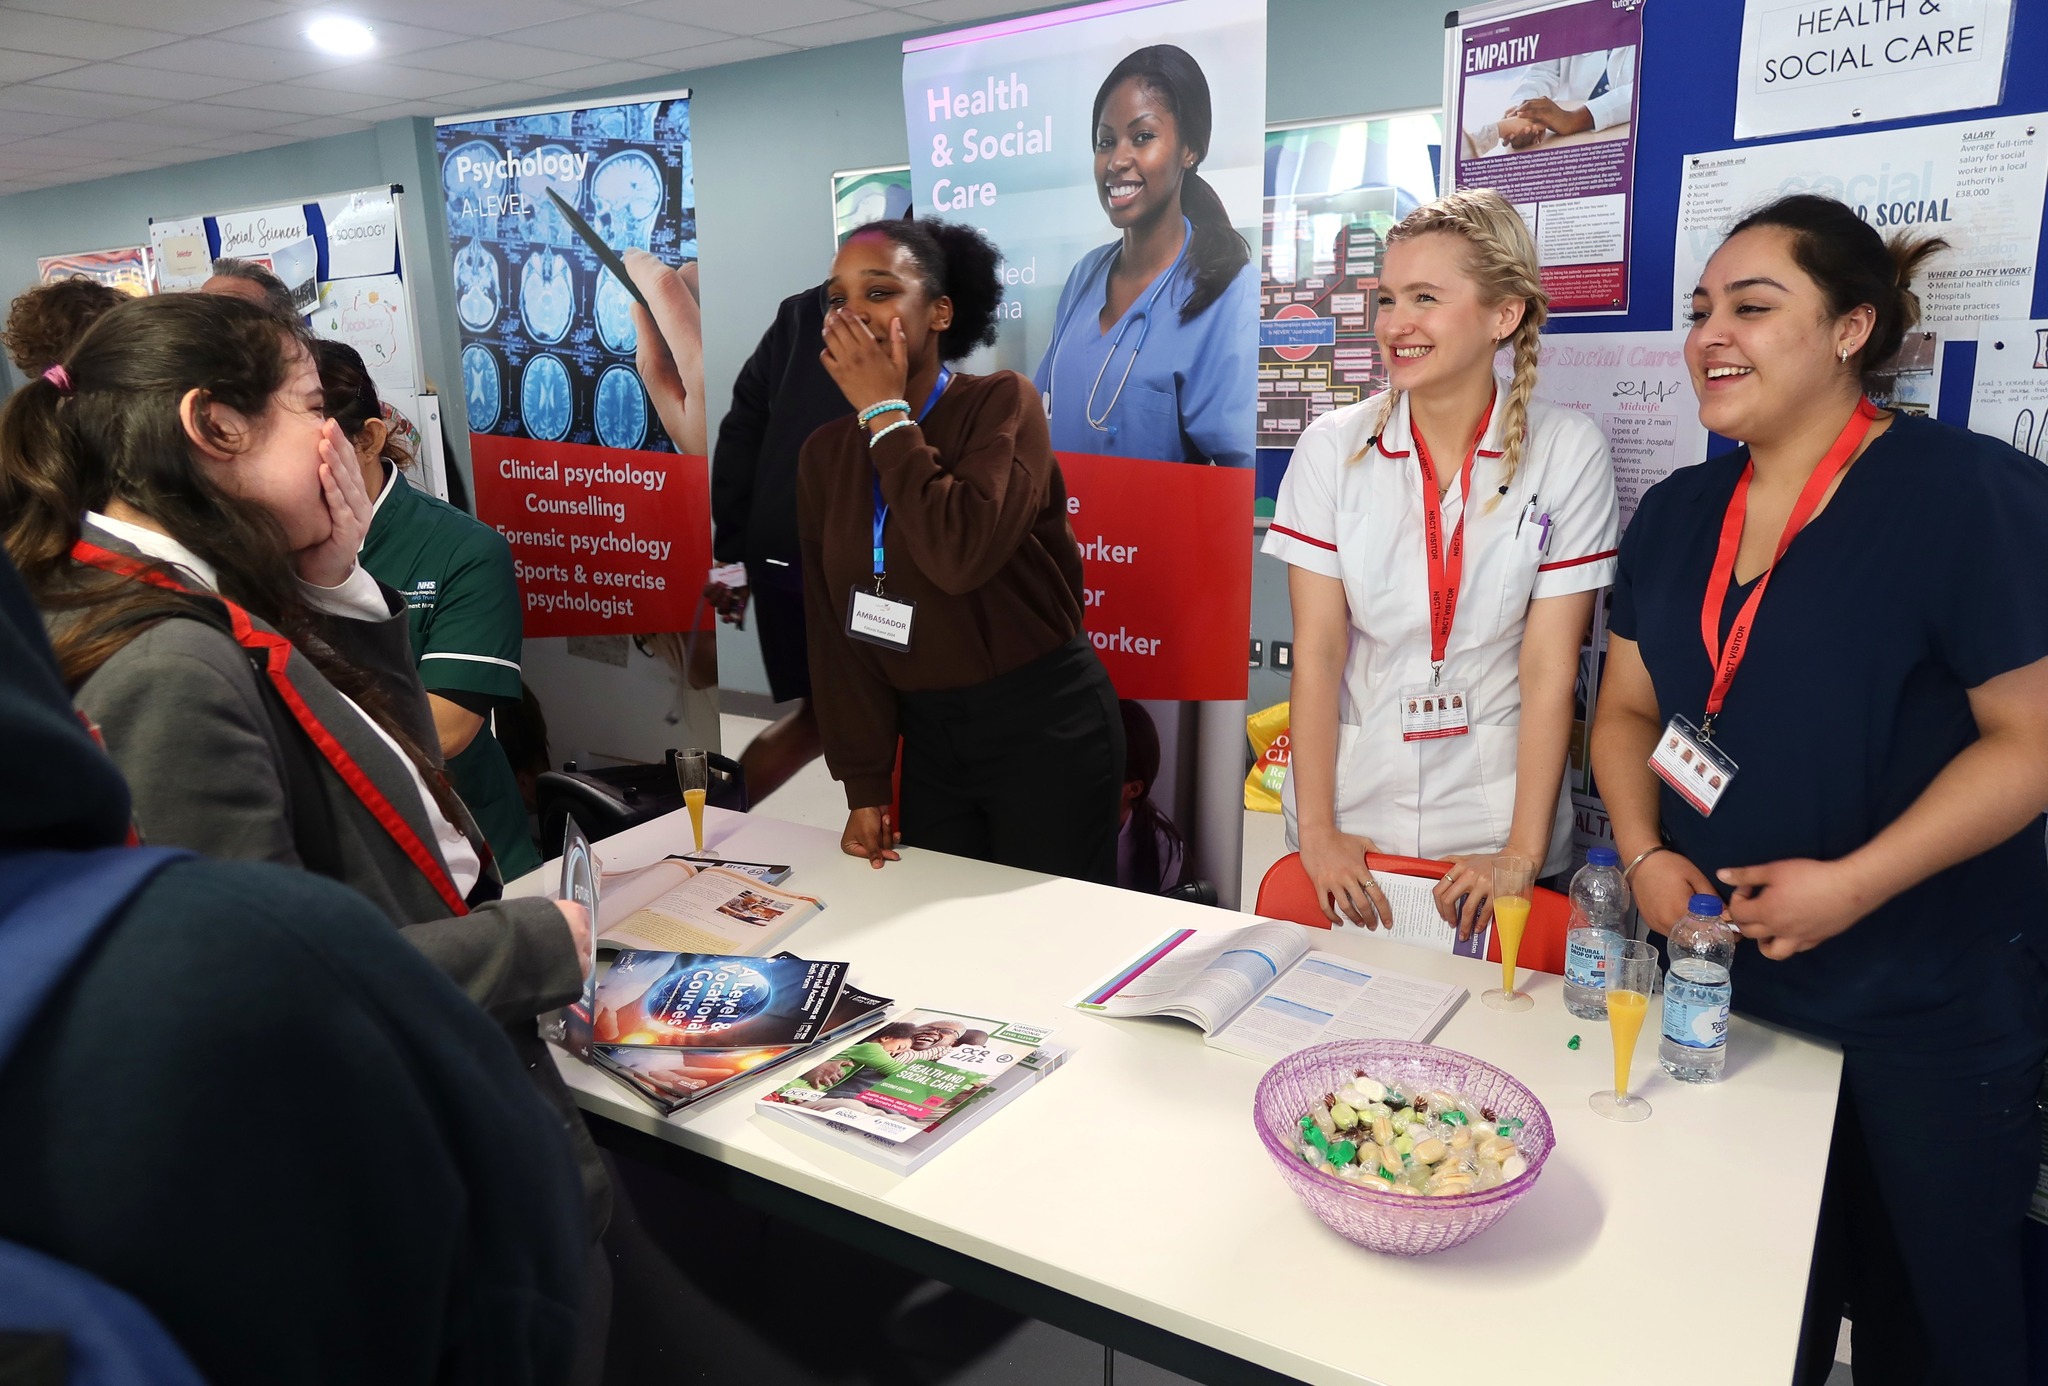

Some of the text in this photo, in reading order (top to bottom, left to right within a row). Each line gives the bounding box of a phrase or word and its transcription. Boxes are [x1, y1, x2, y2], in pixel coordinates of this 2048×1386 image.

[1797, 0, 1941, 37] HEALTH &
[1465, 34, 1540, 74] EMPATHY
[1764, 26, 1975, 83] SOCIAL CARE
[928, 73, 1028, 122] Health
[931, 116, 1052, 168] & Social
[1962, 130, 1995, 141] SALARY
[1960, 138, 2033, 153] Average full-time
[1960, 151, 2025, 165] salary for social
[456, 147, 589, 189] Psychology
[1958, 166, 1987, 175] worker
[2007, 162, 2027, 171] local
[1956, 177, 1996, 188] authority
[932, 178, 997, 212] Care
[1956, 188, 1990, 198] £38,000
[462, 194, 531, 218] A-LEVEL
[1876, 198, 1953, 228] SOCIAL
[224, 217, 302, 252] Social Sciences
[337, 224, 387, 241] SOCIOLOGY
[1928, 266, 2032, 279] WHERE DO THEY WORK?
[1936, 279, 2021, 290] Mental health clinics
[1935, 292, 1971, 301] Hospitals
[1934, 302, 2000, 312] Private practices
[1934, 314, 2000, 322] Local authorities
[1558, 346, 1622, 368] Social
[1627, 346, 1682, 368] Care
[1618, 402, 1660, 414] Midwife
[1613, 417, 1633, 426] There
[1648, 418, 1653, 426] 2
[1612, 427, 1630, 436] types
[1611, 436, 1675, 447] midwives: hospital
[1617, 447, 1655, 456] community
[500, 460, 667, 491] Clinical psychology
[1420, 456, 1433, 481] VISITOR
[1641, 468, 1668, 476] provide
[526, 494, 626, 523] Counselling
[496, 524, 672, 561] Forensic psychology
[1429, 510, 1438, 561] NSCT VISITOR
[514, 560, 666, 591] Sports & exercise
[417, 582, 436, 590] NHS
[526, 590, 634, 620] psychologist
[1441, 588, 1455, 636] NSCT VISITOR
[856, 610, 907, 630] AMBASSADOR
[1723, 625, 1746, 685] NSCT VISITOR
[1570, 948, 1584, 957] DROP
[1575, 945, 1600, 955] NATURAL
[802, 963, 819, 989] Sixth Form
[825, 964, 840, 986] Continue
[801, 964, 830, 1012] Heron Hall Academy
[820, 986, 830, 998] your
[668, 970, 713, 1026] Courses
[684, 964, 741, 1034] Vocational
[708, 966, 759, 1032] A Level &
[812, 998, 825, 1015] success
[962, 1048, 991, 1057] OCR
[896, 1070, 960, 1093] SOCIAL CARE
[907, 1064, 966, 1084] HEALTH AND
[786, 1089, 808, 1097] OCR
[880, 1082, 914, 1095] SECOND EDITION
[835, 1110, 858, 1120] Boost
[826, 1120, 849, 1134] Boost
[884, 1121, 907, 1131] HODDER
[872, 1134, 897, 1147] HODDER
